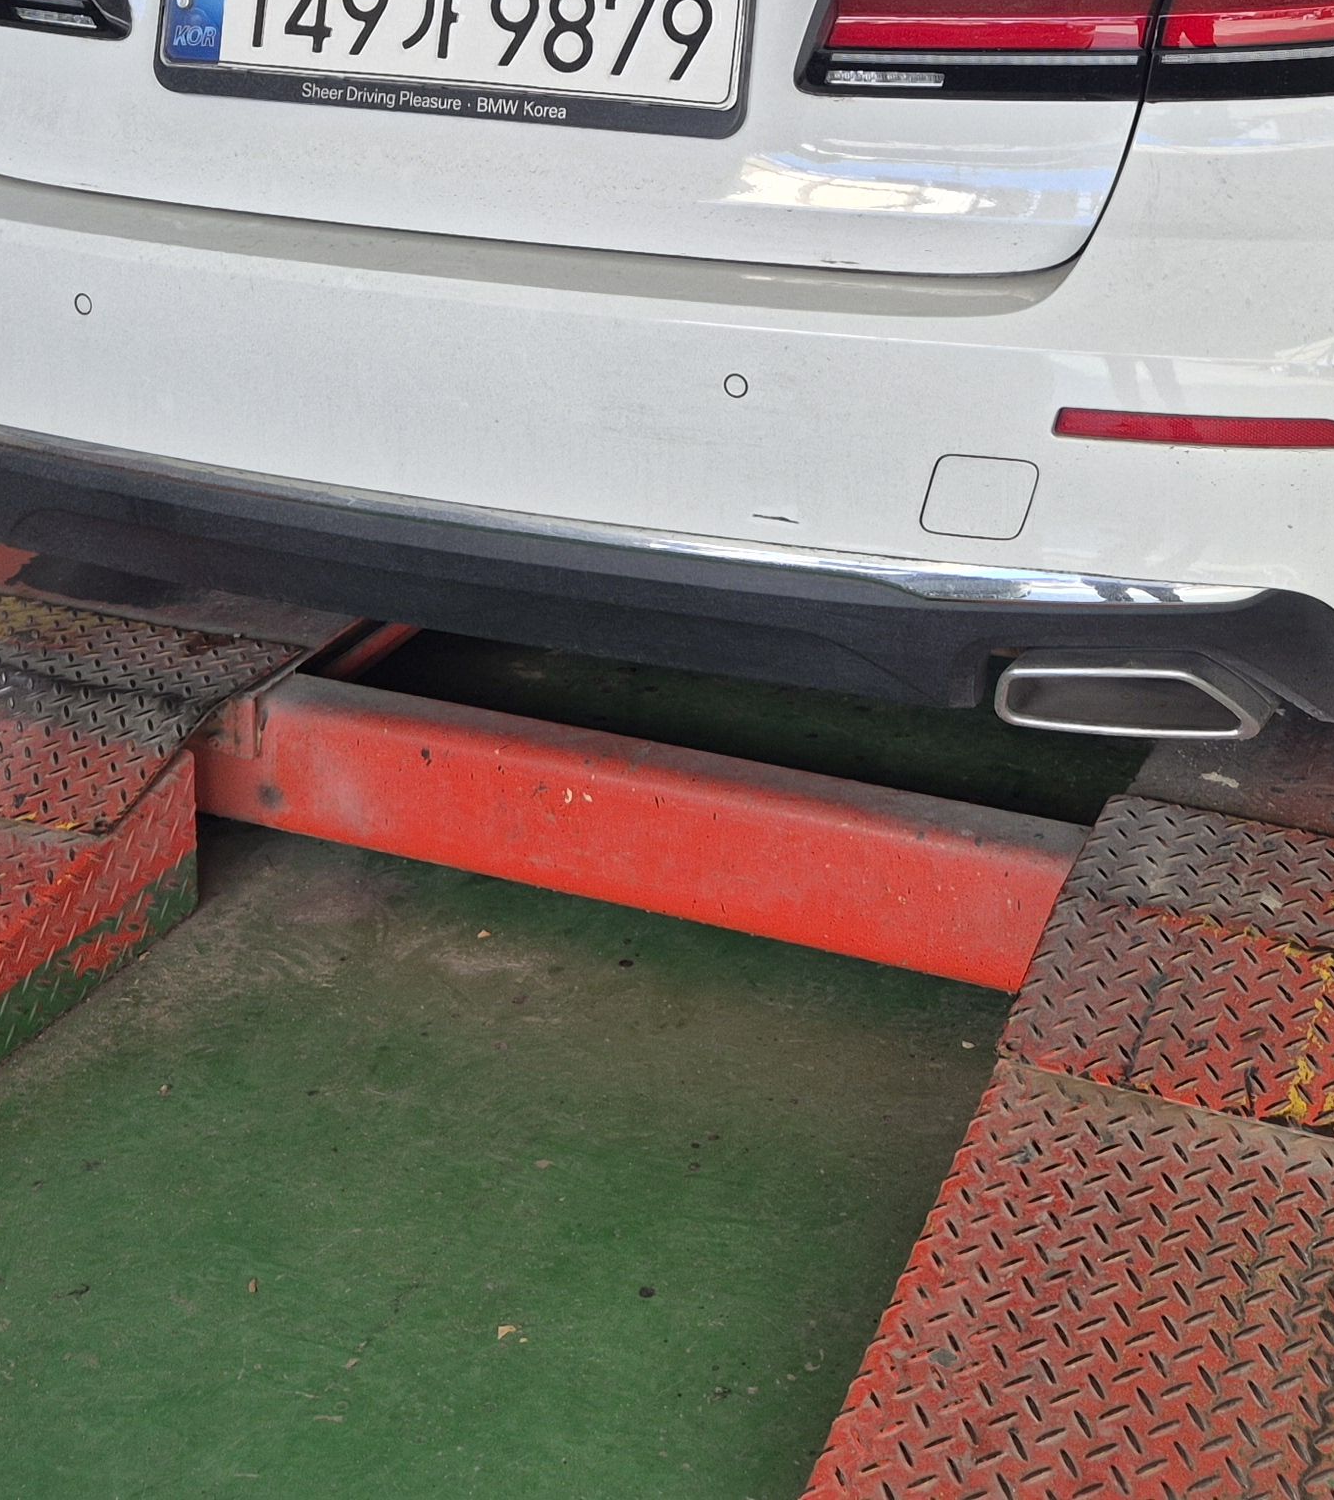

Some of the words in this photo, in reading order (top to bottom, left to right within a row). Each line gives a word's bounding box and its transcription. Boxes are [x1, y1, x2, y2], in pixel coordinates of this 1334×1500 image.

[173, 24, 217, 48] KOR
[301, 82, 344, 100] Sheer
[346, 86, 396, 109] Driving
[399, 90, 462, 111] Pleasure
[476, 97, 519, 115] BMW
[523, 101, 567, 119] Korea
